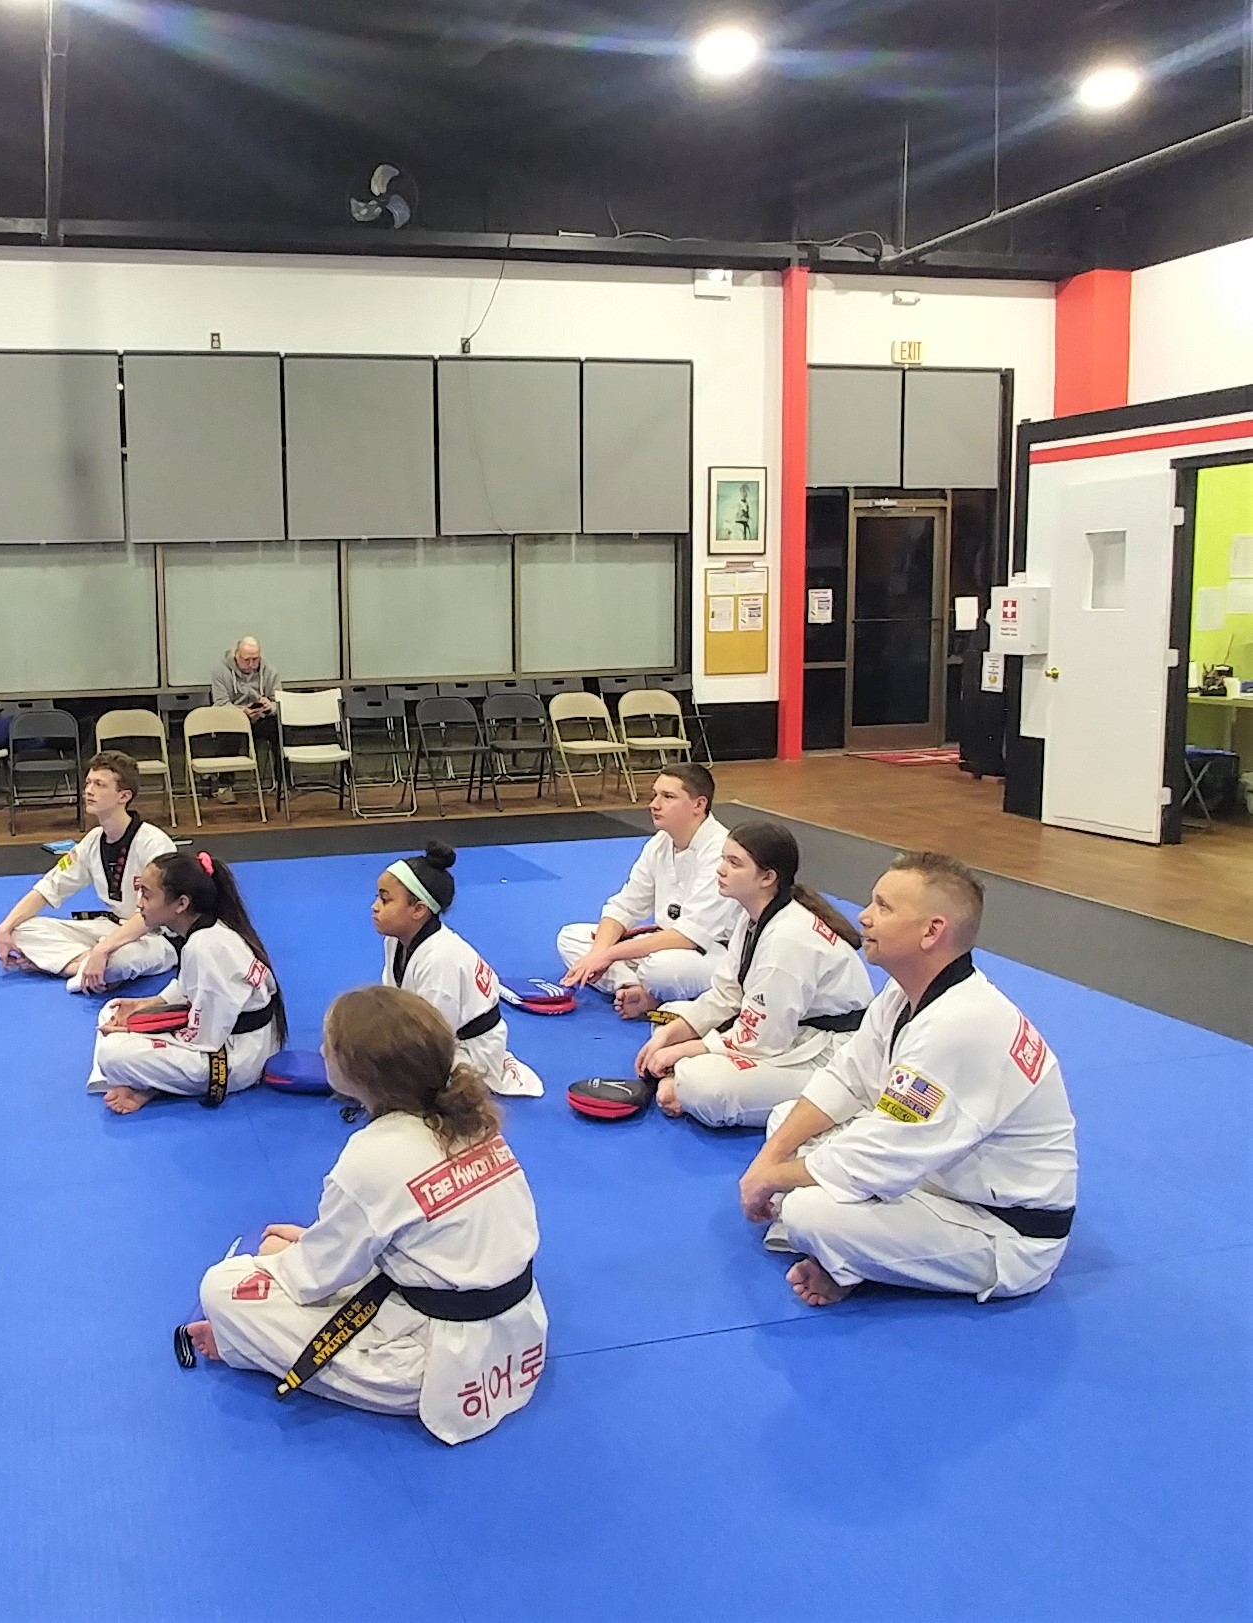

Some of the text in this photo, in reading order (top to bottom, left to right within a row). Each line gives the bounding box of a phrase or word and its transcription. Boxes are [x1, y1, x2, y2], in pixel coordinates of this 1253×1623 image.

[900, 341, 923, 361] EXIT
[419, 1176, 455, 1206] Tae
[450, 1156, 494, 1190] Kwon
[457, 1342, 543, 1419] 히어로
